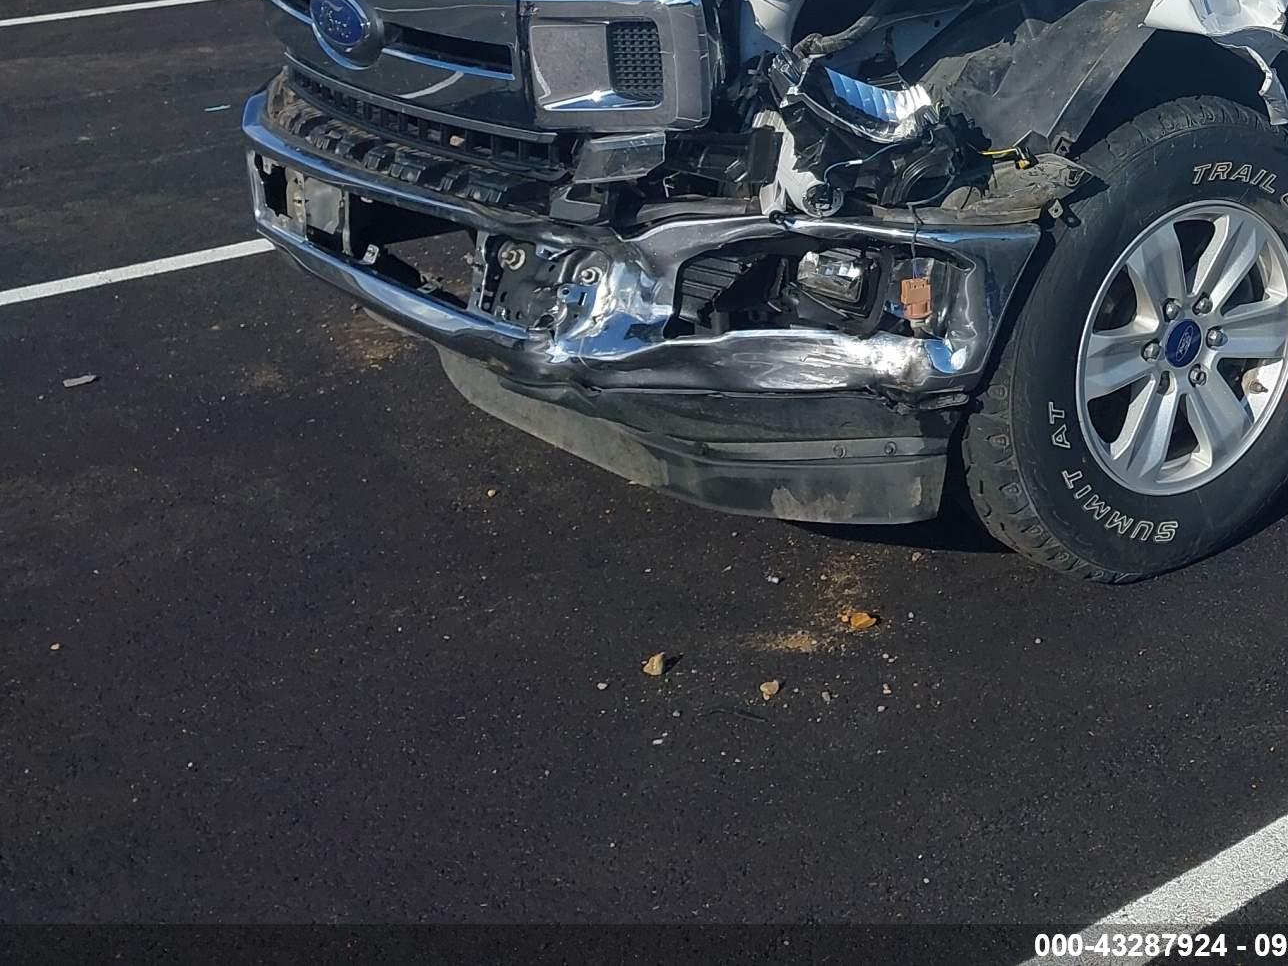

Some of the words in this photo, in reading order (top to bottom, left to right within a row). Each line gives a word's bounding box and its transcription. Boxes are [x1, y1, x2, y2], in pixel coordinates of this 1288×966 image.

[1193, 161, 1277, 194] TRAIL
[1047, 401, 1072, 449] AT
[1062, 468, 1178, 543] SUMMIT
